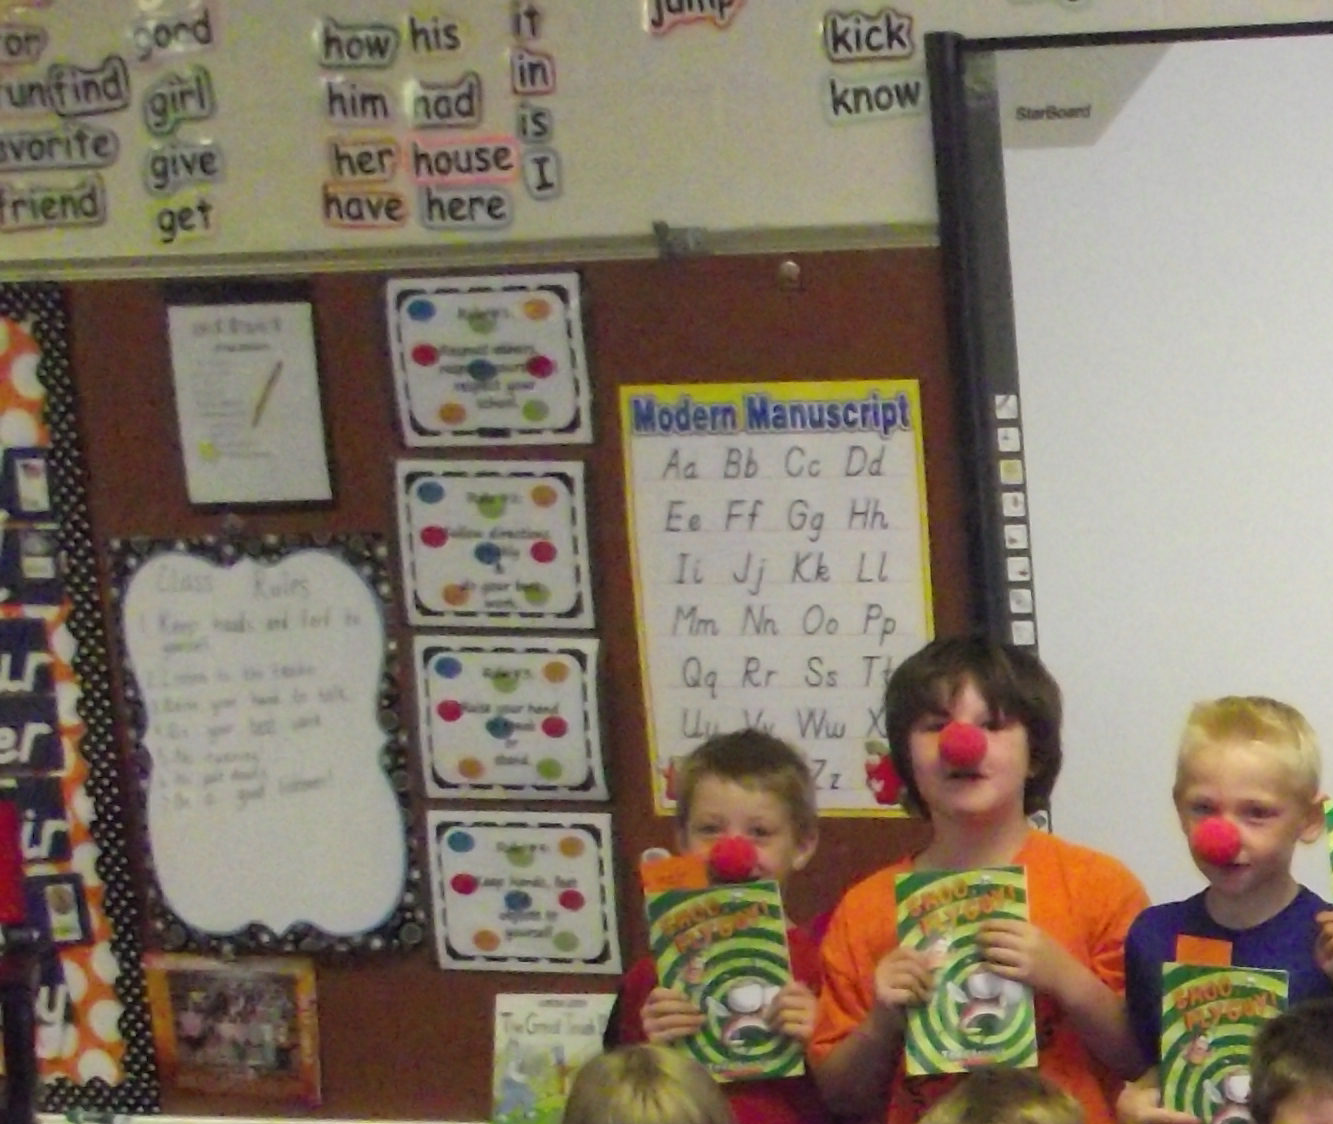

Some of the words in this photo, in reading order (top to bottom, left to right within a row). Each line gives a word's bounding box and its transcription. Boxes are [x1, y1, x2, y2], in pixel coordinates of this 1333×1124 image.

[410, 18, 461, 52] his
[513, 7, 540, 37] it
[829, 20, 910, 54] kick
[323, 29, 392, 60] how
[53, 66, 123, 104] find
[516, 55, 548, 89] in
[150, 78, 206, 132] girl
[328, 83, 391, 120] him
[413, 84, 475, 120] had
[830, 77, 921, 116] know
[1014, 103, 1092, 122] StarBoard
[518, 107, 548, 139] is
[150, 147, 217, 189] give
[332, 143, 393, 176] her
[413, 142, 514, 175] house
[532, 157, 554, 191] I
[324, 185, 403, 222] have
[426, 187, 506, 222] here
[157, 200, 213, 243] get
[634, 398, 736, 432] Modern
[747, 393, 911, 436] Manuscript
[662, 448, 699, 480] Aa
[723, 448, 759, 479] Bb
[784, 447, 821, 478] Cc
[845, 445, 886, 477] Dd
[665, 501, 701, 533] Ee
[725, 500, 763, 532] Ff
[787, 500, 824, 542] Gg
[847, 500, 889, 531] Hh
[733, 551, 765, 595] Jj
[791, 552, 831, 584] Kk
[856, 551, 889, 583] Ll
[672, 606, 719, 637] Mm
[741, 604, 779, 636] Nn
[803, 604, 839, 635] Oo
[862, 602, 896, 643] Pp
[682, 656, 718, 698] Qq
[742, 657, 779, 688] Rr
[805, 657, 838, 688] Ss
[797, 709, 846, 740] Ww
